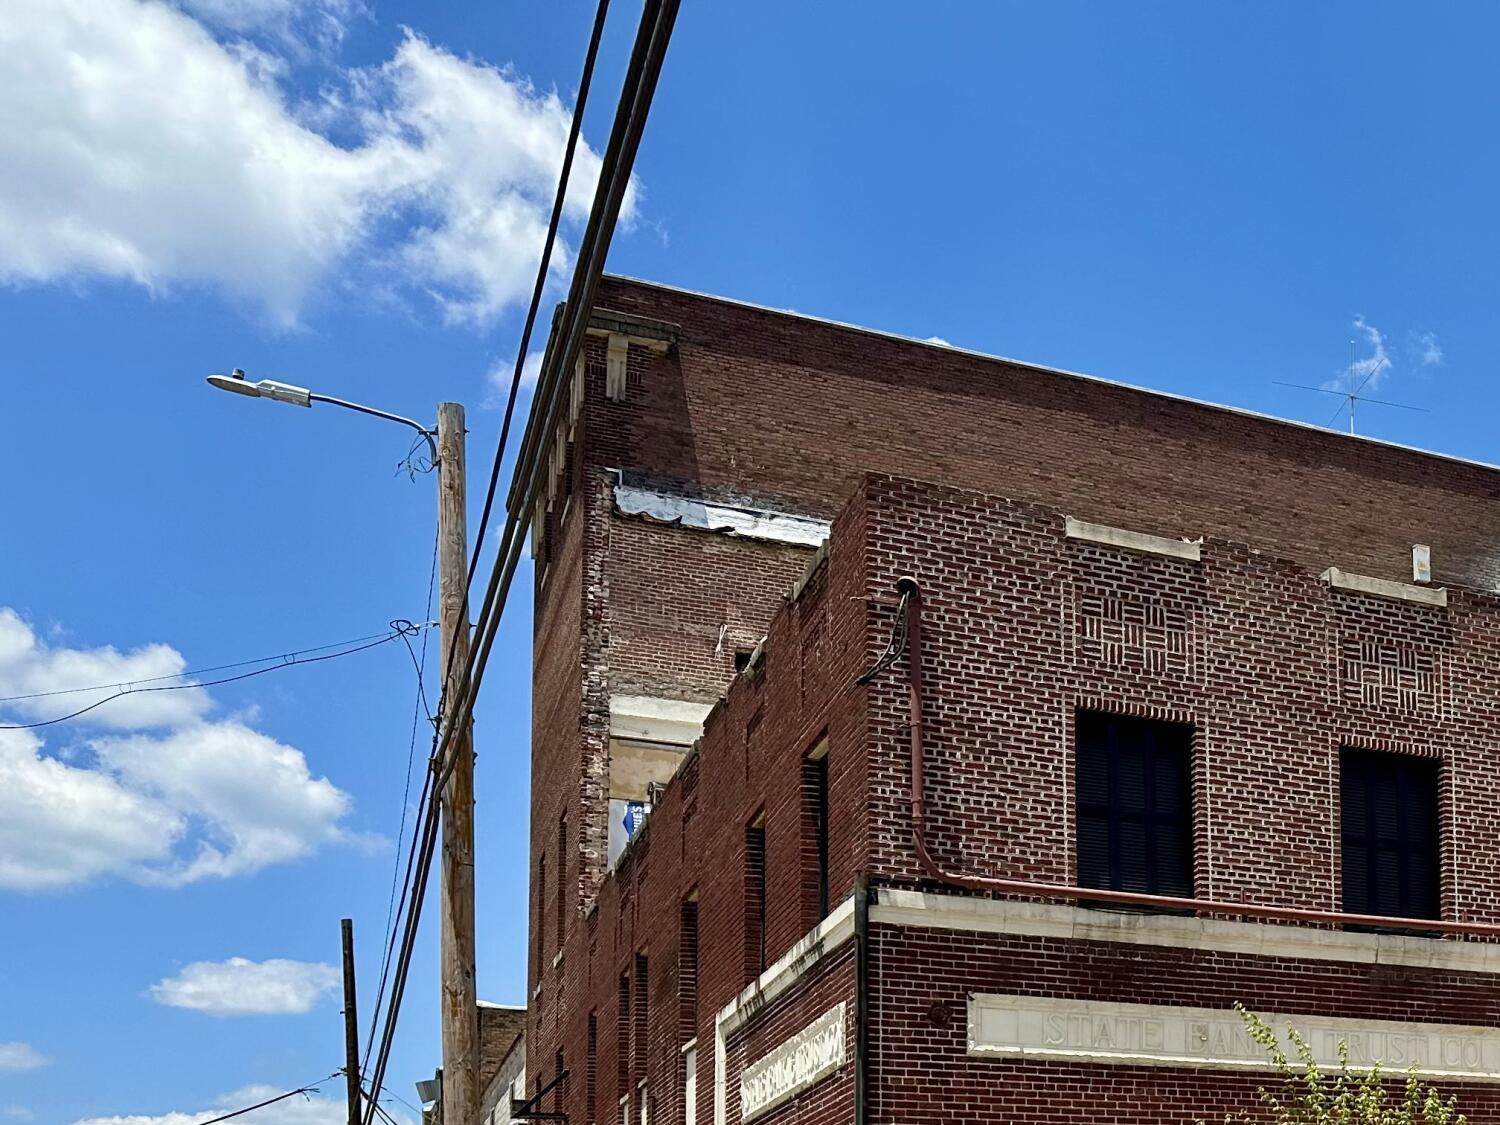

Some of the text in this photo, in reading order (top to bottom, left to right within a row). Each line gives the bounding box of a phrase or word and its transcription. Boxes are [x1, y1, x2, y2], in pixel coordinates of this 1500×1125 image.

[1046, 1010, 1163, 1051] STATE
[1185, 1023, 1270, 1058] BAN
[1323, 1032, 1429, 1068] TRUST
